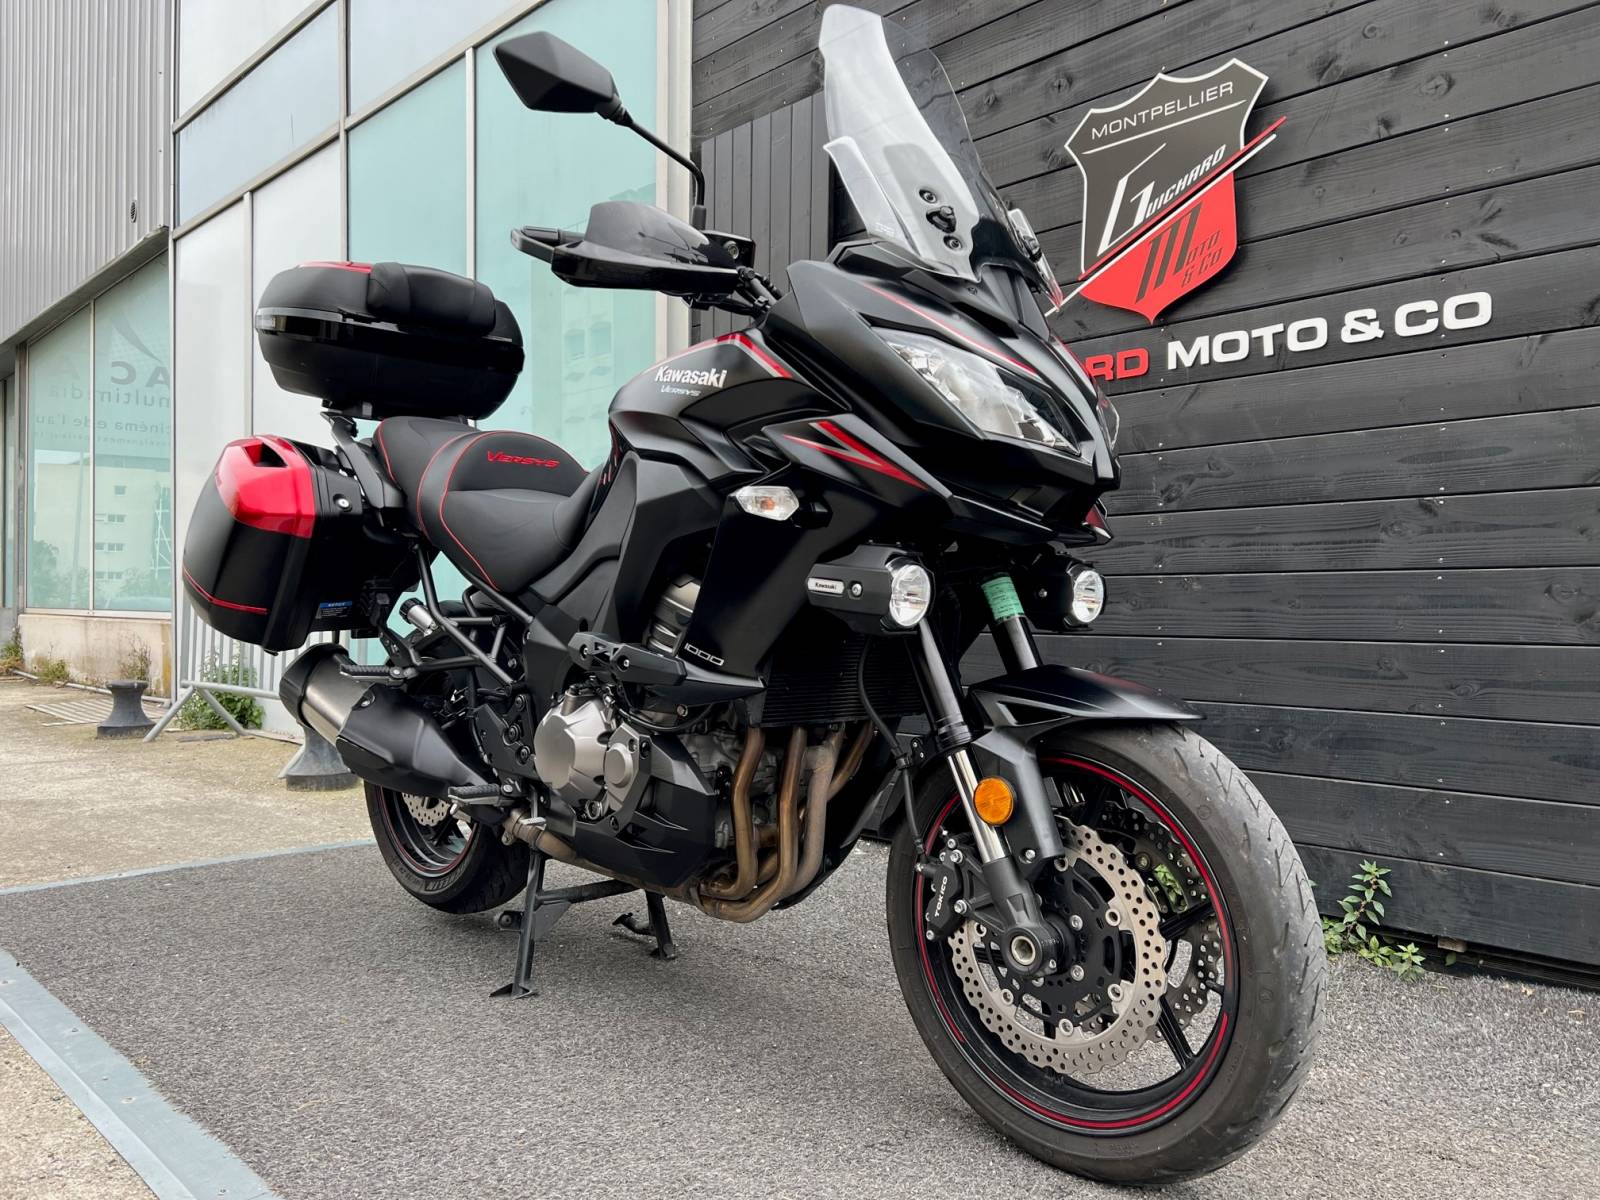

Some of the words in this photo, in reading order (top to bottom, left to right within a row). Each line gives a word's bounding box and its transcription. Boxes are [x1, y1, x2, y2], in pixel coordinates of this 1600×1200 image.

[1090, 80, 1235, 141] MONTPELLIER
[1083, 347, 1149, 381] RD
[1166, 316, 1329, 371] MOTO
[1340, 307, 1385, 344] &
[1393, 291, 1493, 338] CO
[655, 365, 728, 389] Kawasaki
[684, 643, 725, 667] 1000
[934, 876, 948, 917] TOKICO
